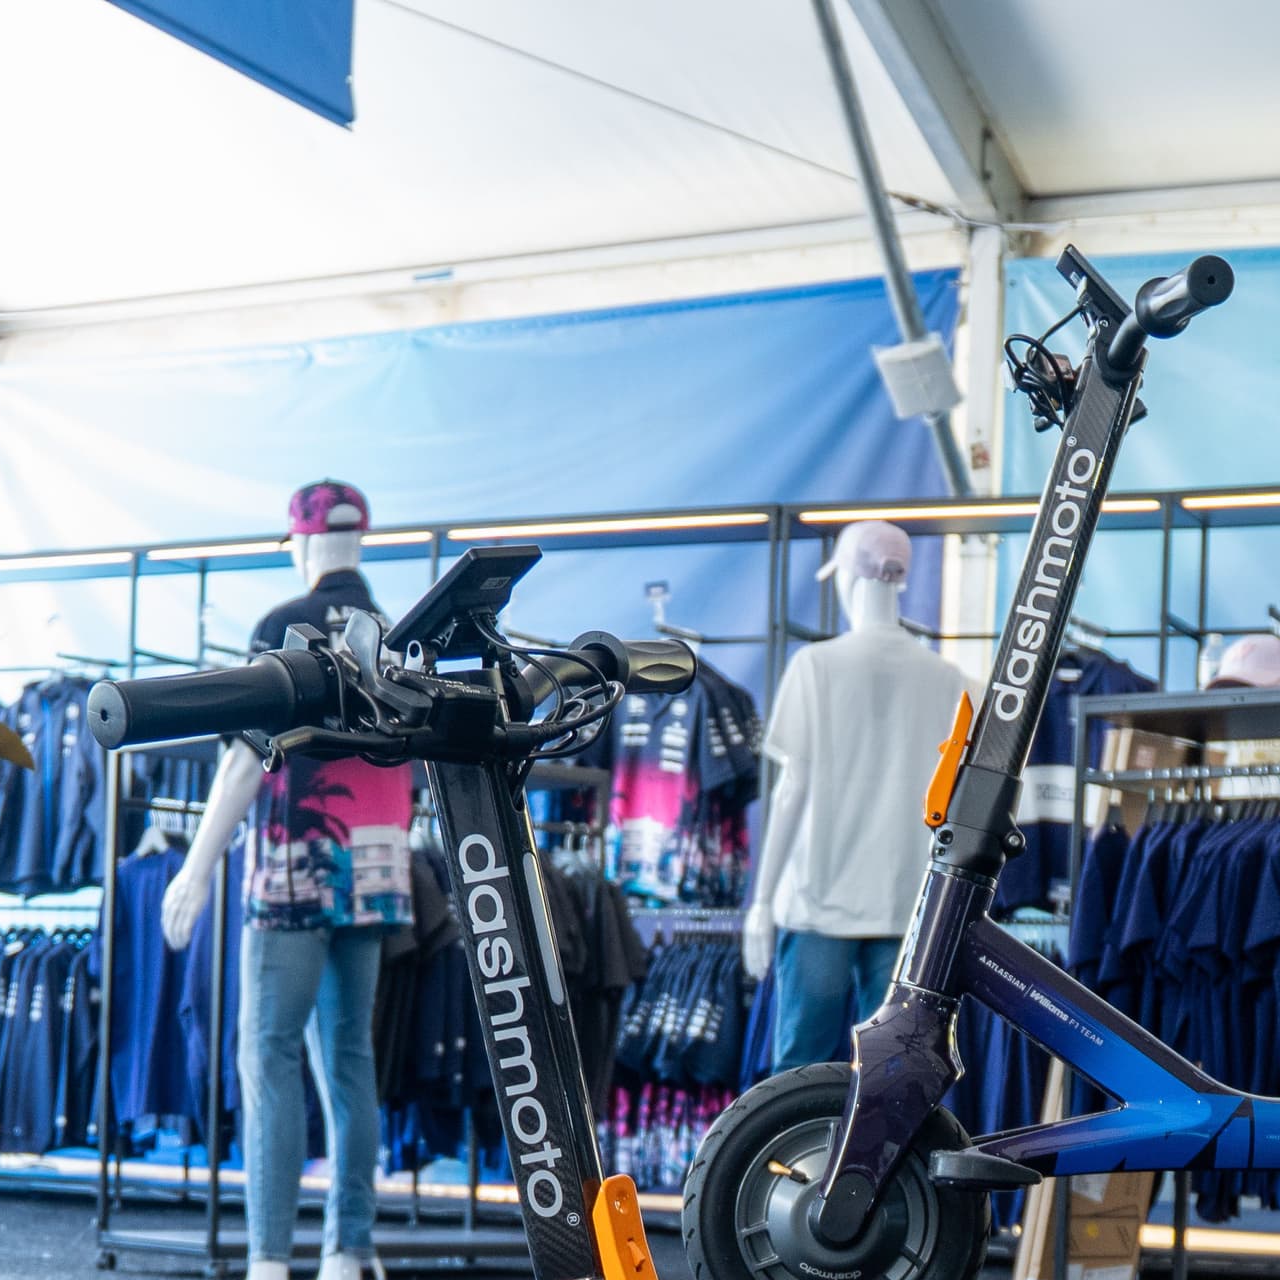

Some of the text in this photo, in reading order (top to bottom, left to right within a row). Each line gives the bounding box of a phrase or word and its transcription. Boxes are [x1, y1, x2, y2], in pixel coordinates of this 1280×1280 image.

[985, 959, 1104, 1047] ATLASSIAN Williams F1 TEAM
